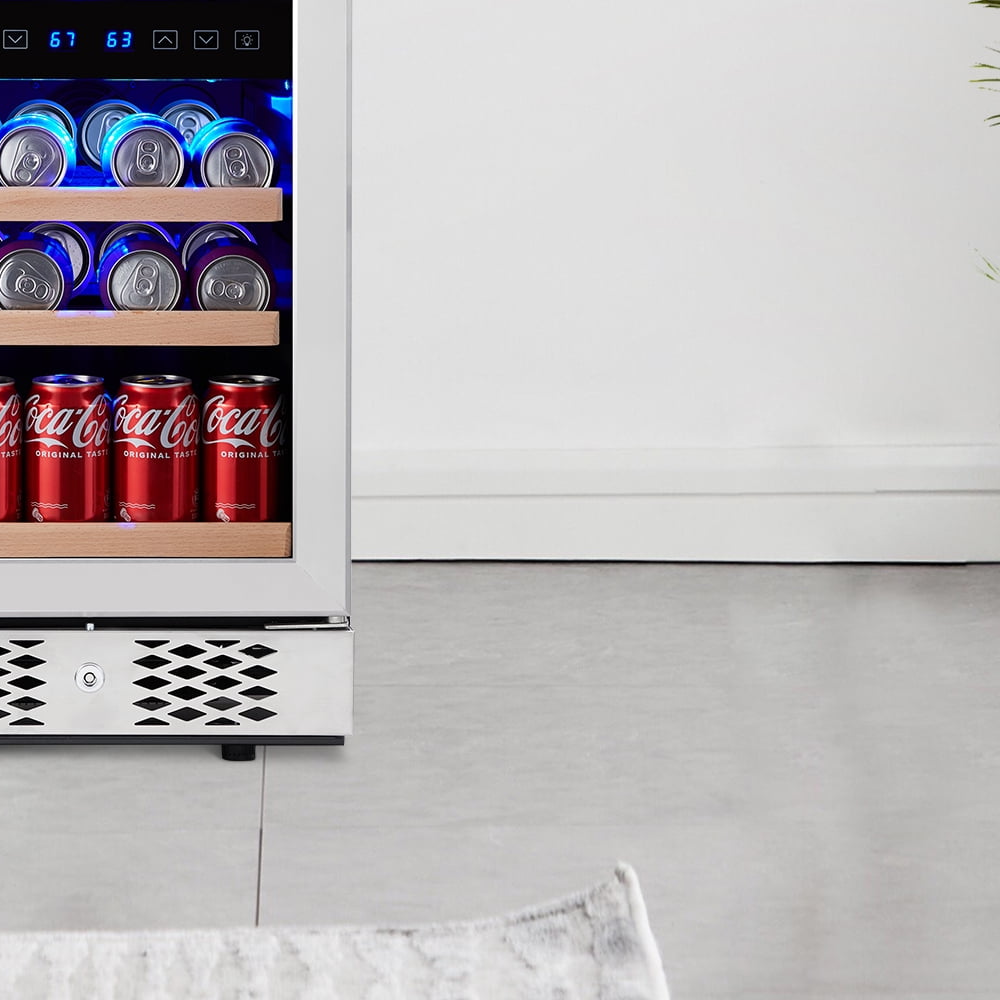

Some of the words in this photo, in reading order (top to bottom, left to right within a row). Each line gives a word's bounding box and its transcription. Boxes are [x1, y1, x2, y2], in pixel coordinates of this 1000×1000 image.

[50, 32, 75, 47] 67
[107, 32, 132, 47] 63
[24, 394, 110, 448] Coca-Co
[114, 394, 199, 449] Coca-Co
[35, 449, 83, 459] ORIGINAL
[123, 450, 171, 459] ORIGINAL
[220, 450, 270, 459] ORIGINAL
